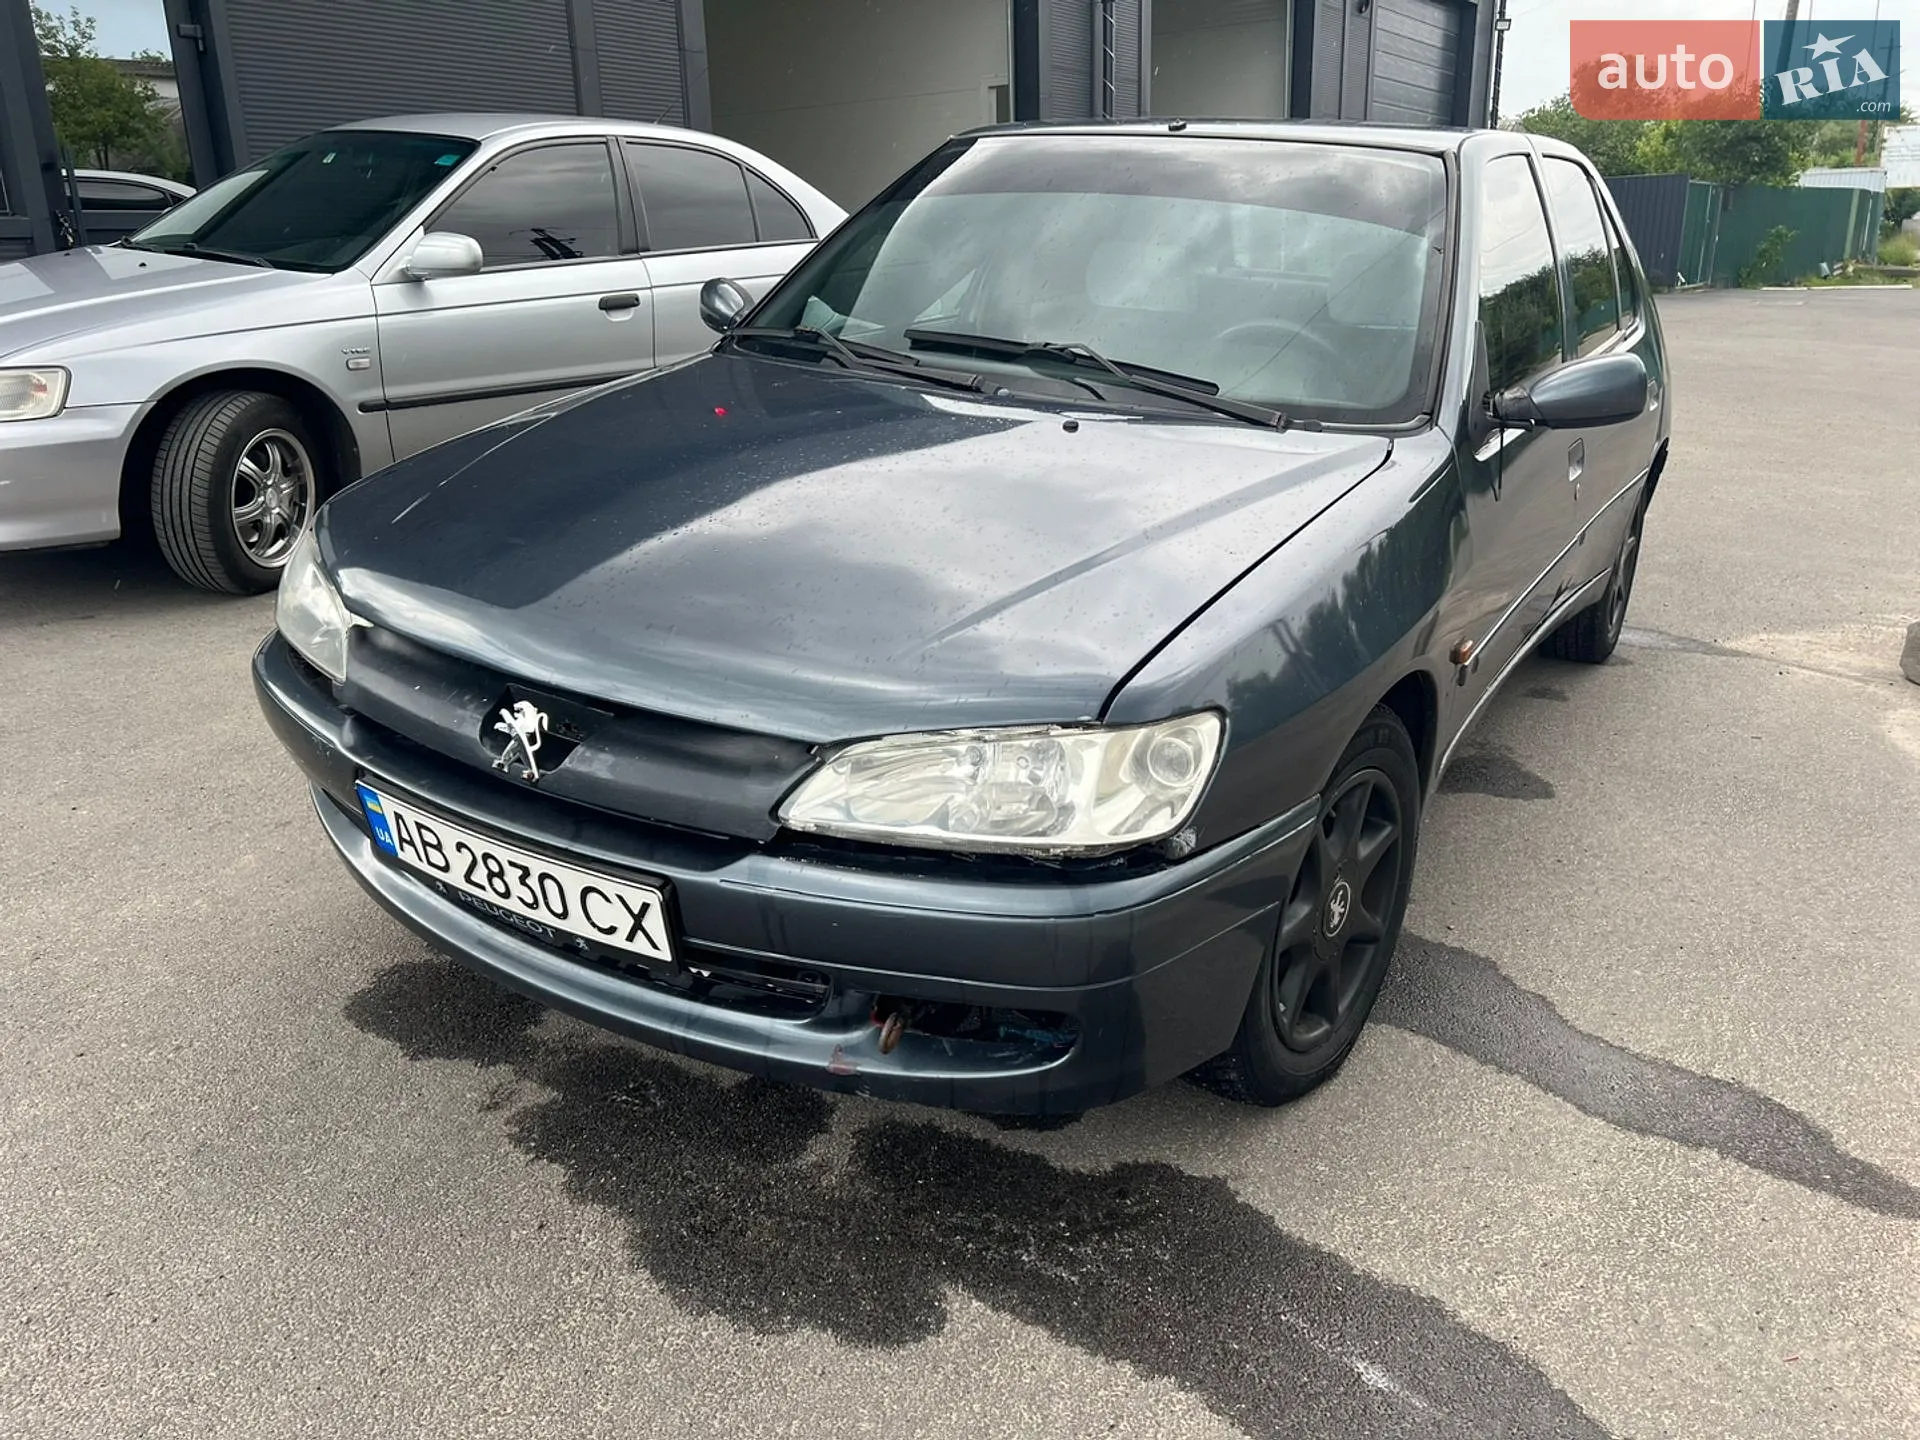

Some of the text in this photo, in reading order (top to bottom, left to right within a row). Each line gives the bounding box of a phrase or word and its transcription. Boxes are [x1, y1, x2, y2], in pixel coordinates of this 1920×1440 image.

[375, 826, 394, 846] UA
[393, 810, 661, 951] AB 2830 CX
